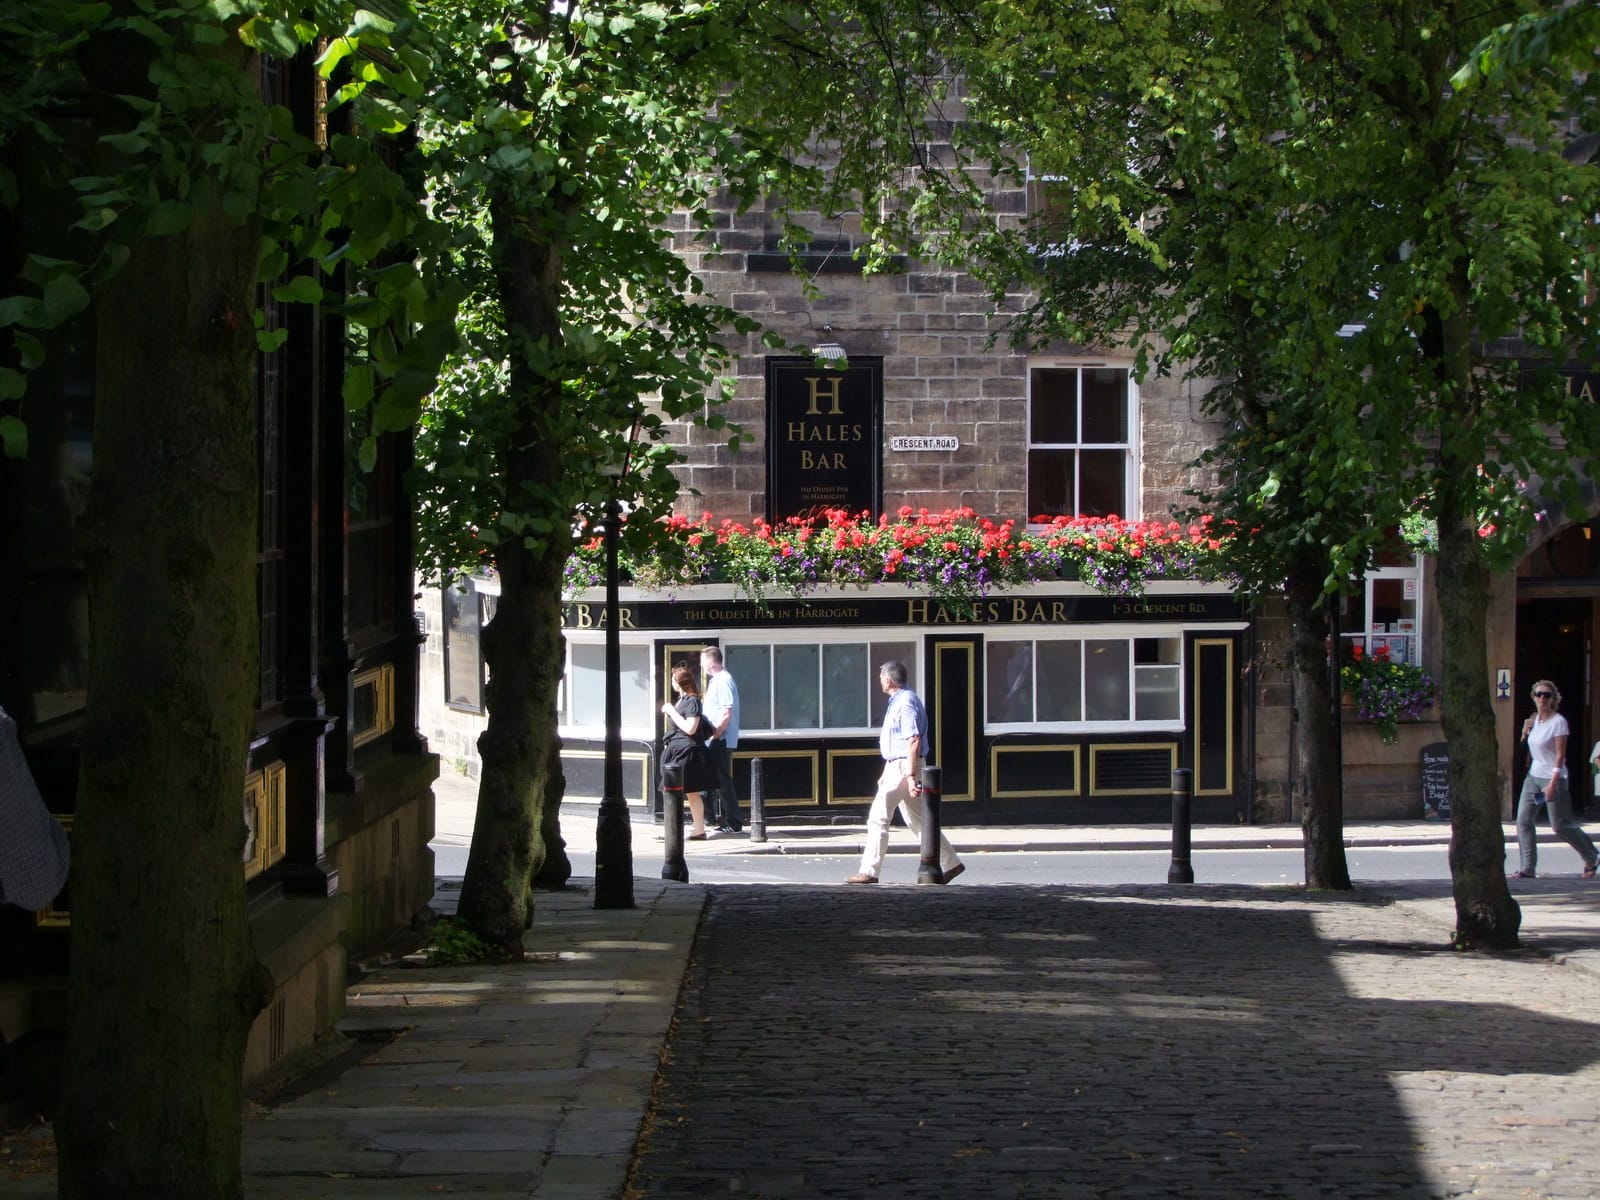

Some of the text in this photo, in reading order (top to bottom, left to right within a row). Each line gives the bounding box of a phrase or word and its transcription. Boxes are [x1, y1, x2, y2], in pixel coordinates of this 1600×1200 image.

[804, 377, 844, 415] H
[787, 422, 862, 441] HALES
[893, 439, 956, 448] CRESCENT ROAD
[801, 450, 848, 470] BAR
[577, 603, 635, 628] BAR
[685, 607, 860, 620] THE OLDEST PUB IN HARROGATE
[907, 599, 1068, 623] HALES BAR
[1134, 603, 1185, 614] CRESCENT
